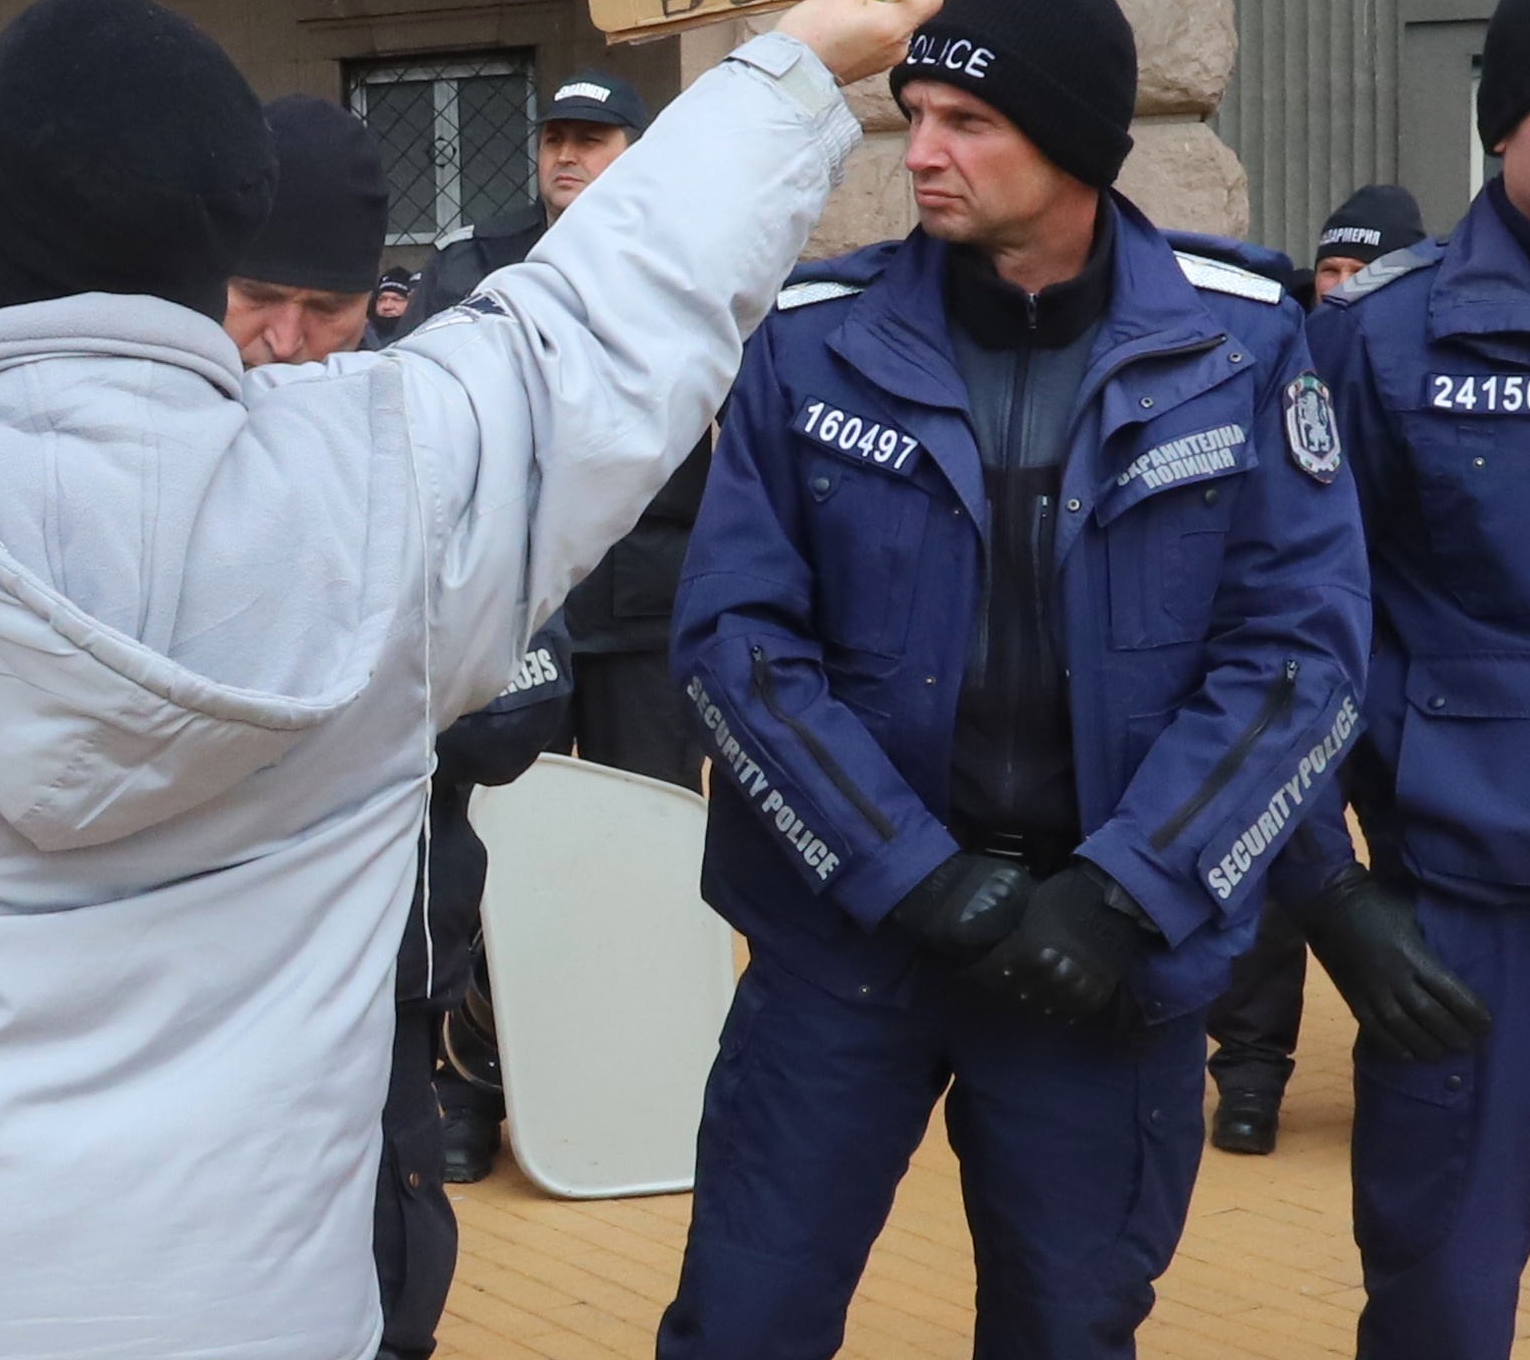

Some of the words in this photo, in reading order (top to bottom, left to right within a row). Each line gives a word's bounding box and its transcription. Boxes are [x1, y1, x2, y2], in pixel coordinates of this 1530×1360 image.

[906, 35, 996, 78] OLICE
[805, 402, 918, 469] 160497
[1117, 424, 1246, 486] ОХРАНИТЕЛНА
[1141, 447, 1236, 489] ПОЛИЦИЯ
[687, 675, 769, 797] SECURITY
[761, 789, 840, 881] POLICE
[1208, 773, 1303, 899] SECURITY
[1298, 696, 1359, 789] POLICE
